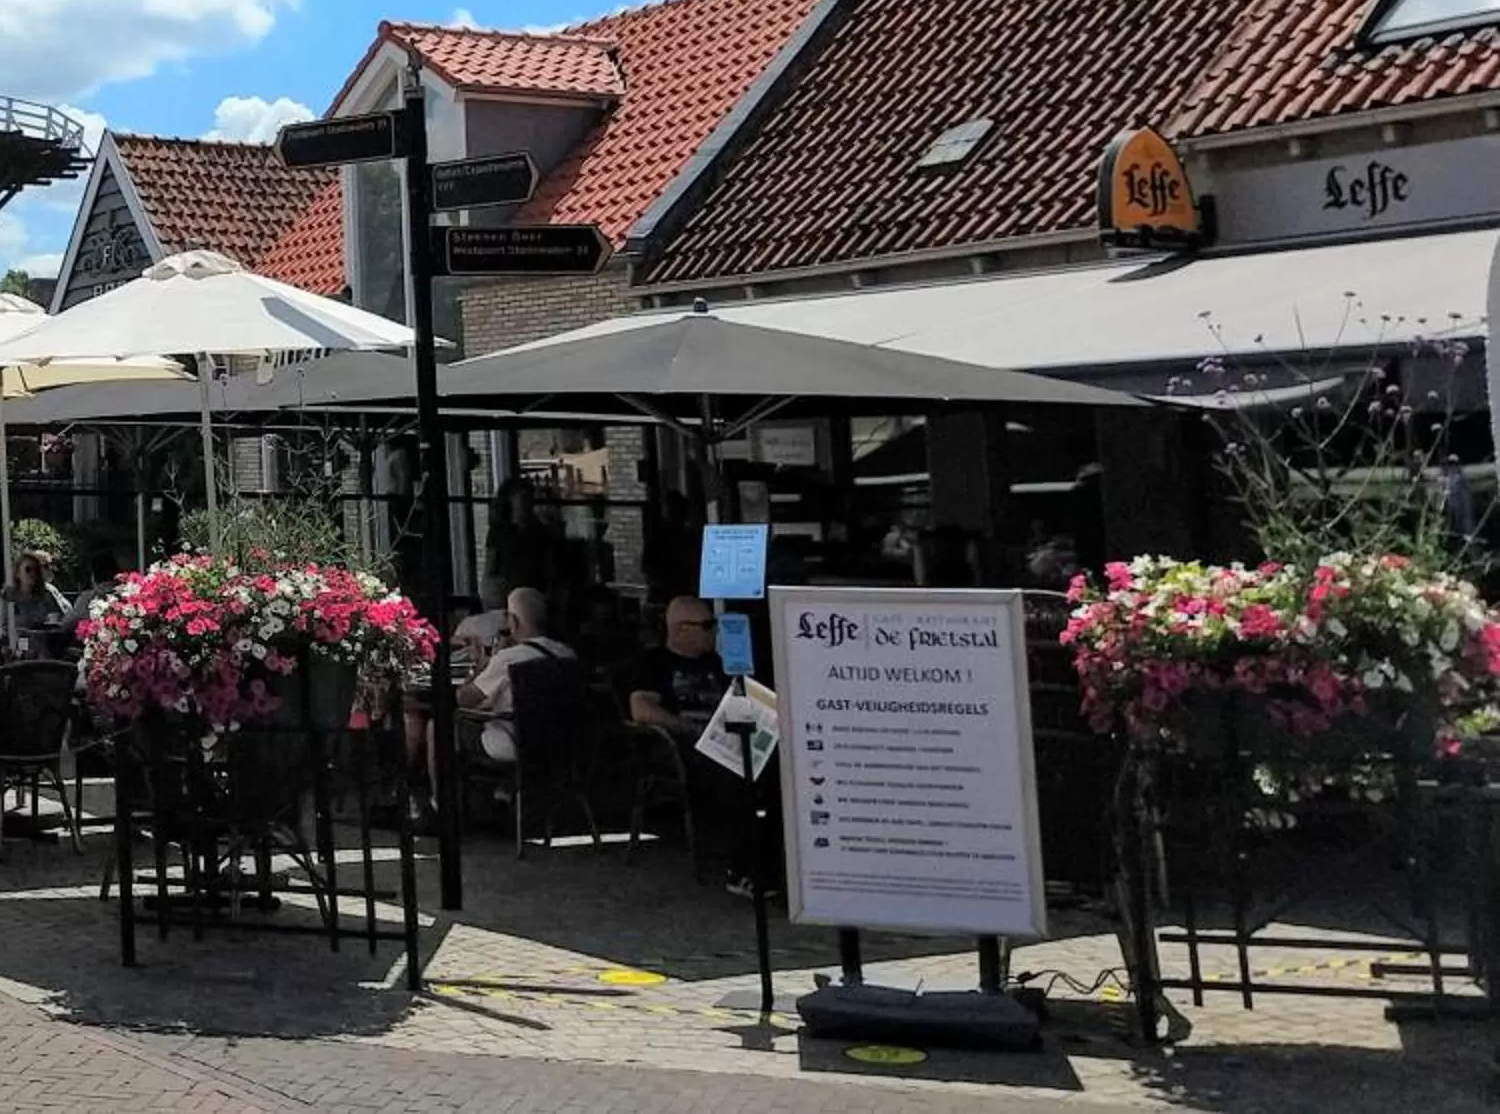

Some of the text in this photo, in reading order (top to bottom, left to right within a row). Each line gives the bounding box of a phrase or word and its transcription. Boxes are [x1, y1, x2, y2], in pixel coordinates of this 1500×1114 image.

[1122, 161, 1181, 217] Leffe
[1322, 159, 1409, 219] Leffe
[796, 611, 859, 648] Leffe
[884, 667, 962, 684] WELKOM
